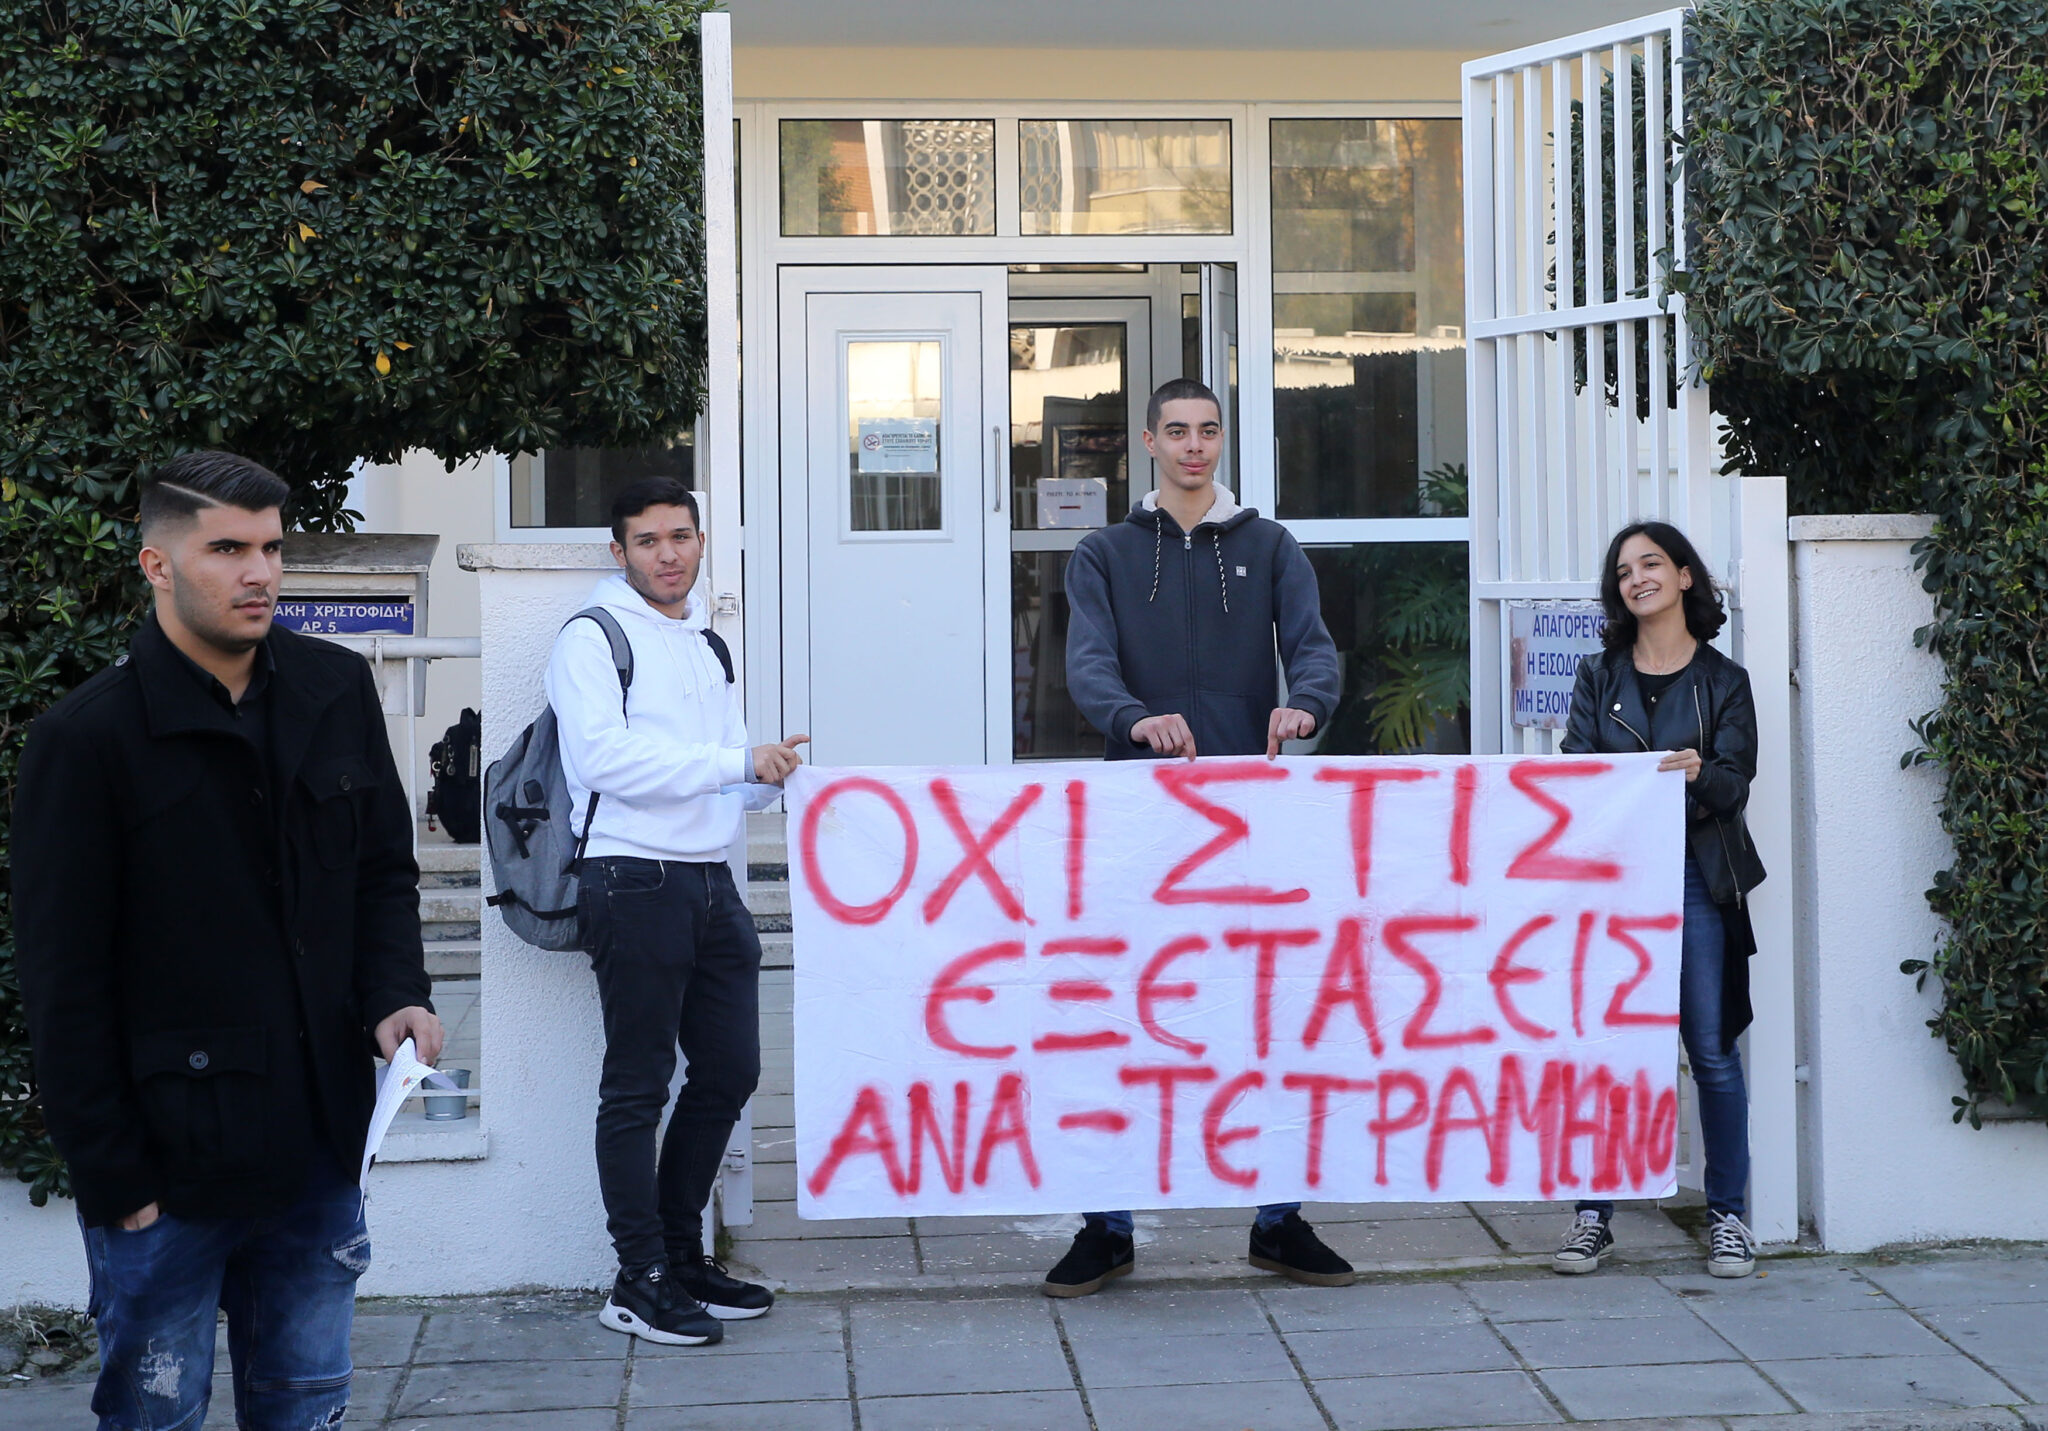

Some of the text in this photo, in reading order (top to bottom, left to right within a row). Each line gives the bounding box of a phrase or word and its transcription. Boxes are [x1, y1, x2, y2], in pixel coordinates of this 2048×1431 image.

[273, 605, 405, 618] ΑΚΗ ΧΡΙΣΤΟΦΙΔΗ
[301, 621, 337, 633] ΑΡ. 5
[1532, 614, 1607, 639] ΑΠΑΓΟΡΕΥΕ
[1527, 652, 1589, 677] Η ΕΙΣΟΔΟ
[1515, 689, 1533, 713] ΜΗ
[800, 761, 1623, 926] ΟΧΙ ΣΤΙΣ
[924, 910, 1684, 1060] ΕΞΕΤΑΣΕΙΣ
